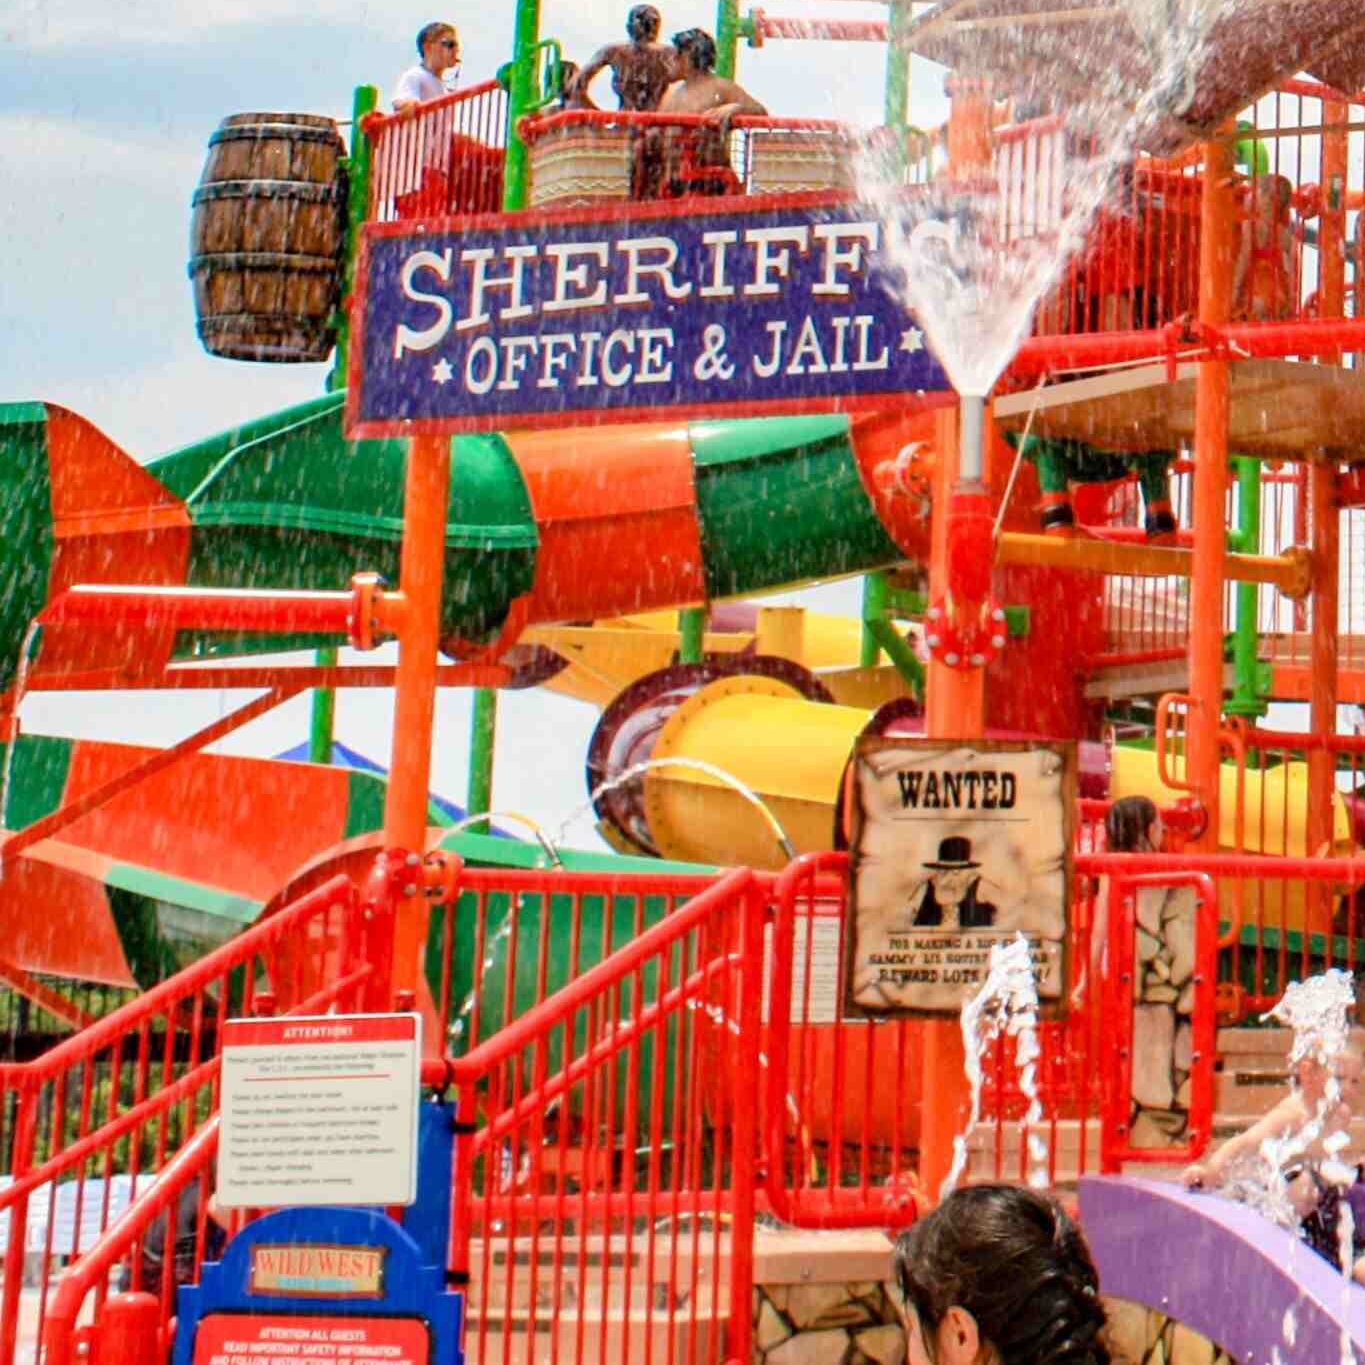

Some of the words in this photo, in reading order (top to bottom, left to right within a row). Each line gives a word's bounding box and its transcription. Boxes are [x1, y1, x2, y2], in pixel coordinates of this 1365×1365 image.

[464, 328, 675, 395] OFFICE
[693, 323, 736, 381] &
[753, 315, 890, 379] JAIL
[897, 770, 1017, 809] WANTED
[284, 1025, 353, 1039] ATTENTION!
[256, 1252, 312, 1276] WILD
[318, 1253, 377, 1278] WEST
[259, 1327, 309, 1340] ATTENTION
[310, 1328, 329, 1341] ALL
